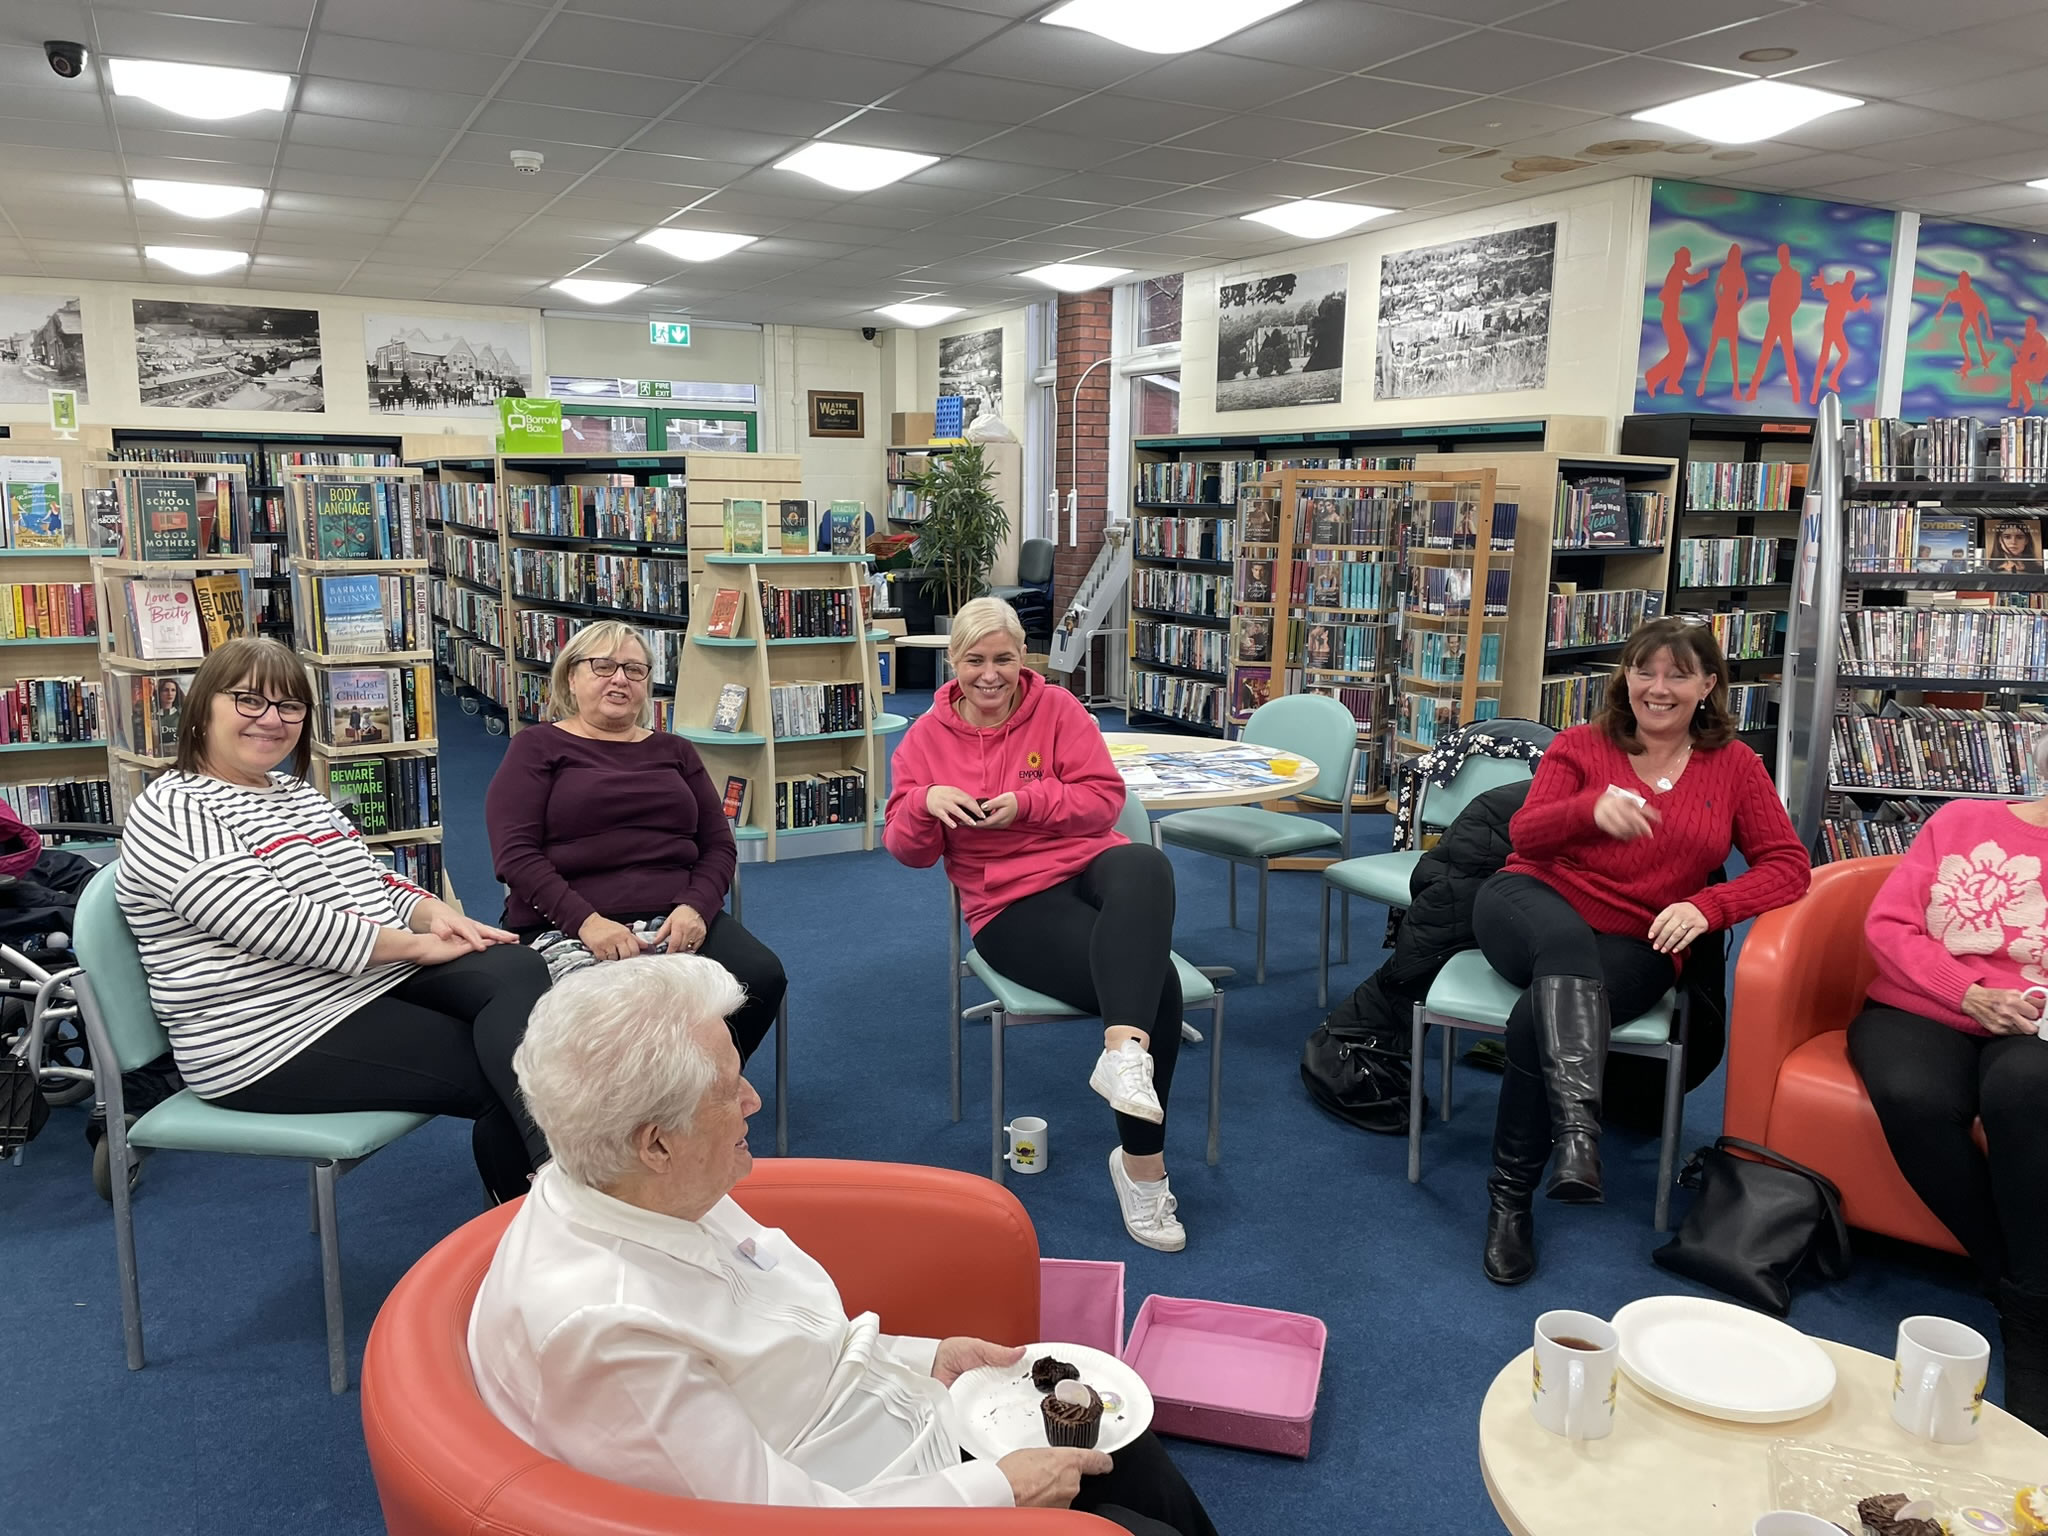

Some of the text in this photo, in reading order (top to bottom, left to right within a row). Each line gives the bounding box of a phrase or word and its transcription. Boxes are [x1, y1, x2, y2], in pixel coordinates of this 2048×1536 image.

[526, 414, 558, 424] Borrow
[158, 490, 177, 498] THE
[330, 488, 358, 501] BODY
[146, 498, 191, 506] SCHOOL
[402, 498, 410, 518] SILVER
[318, 502, 370, 516] LANGUAGE
[1590, 512, 1616, 531] Teens
[1920, 521, 1964, 530] OYRIDE
[330, 585, 375, 594] BARBARA
[198, 588, 216, 622] CATCH-22
[329, 594, 377, 604] DELINSKY
[417, 592, 426, 614] CLEANER
[356, 680, 378, 688] Lost
[336, 690, 384, 701] Children
[331, 768, 375, 782] BEWARE
[340, 782, 383, 794] BEWARE
[352, 801, 385, 815] STEPH
[364, 815, 386, 828] CHA
